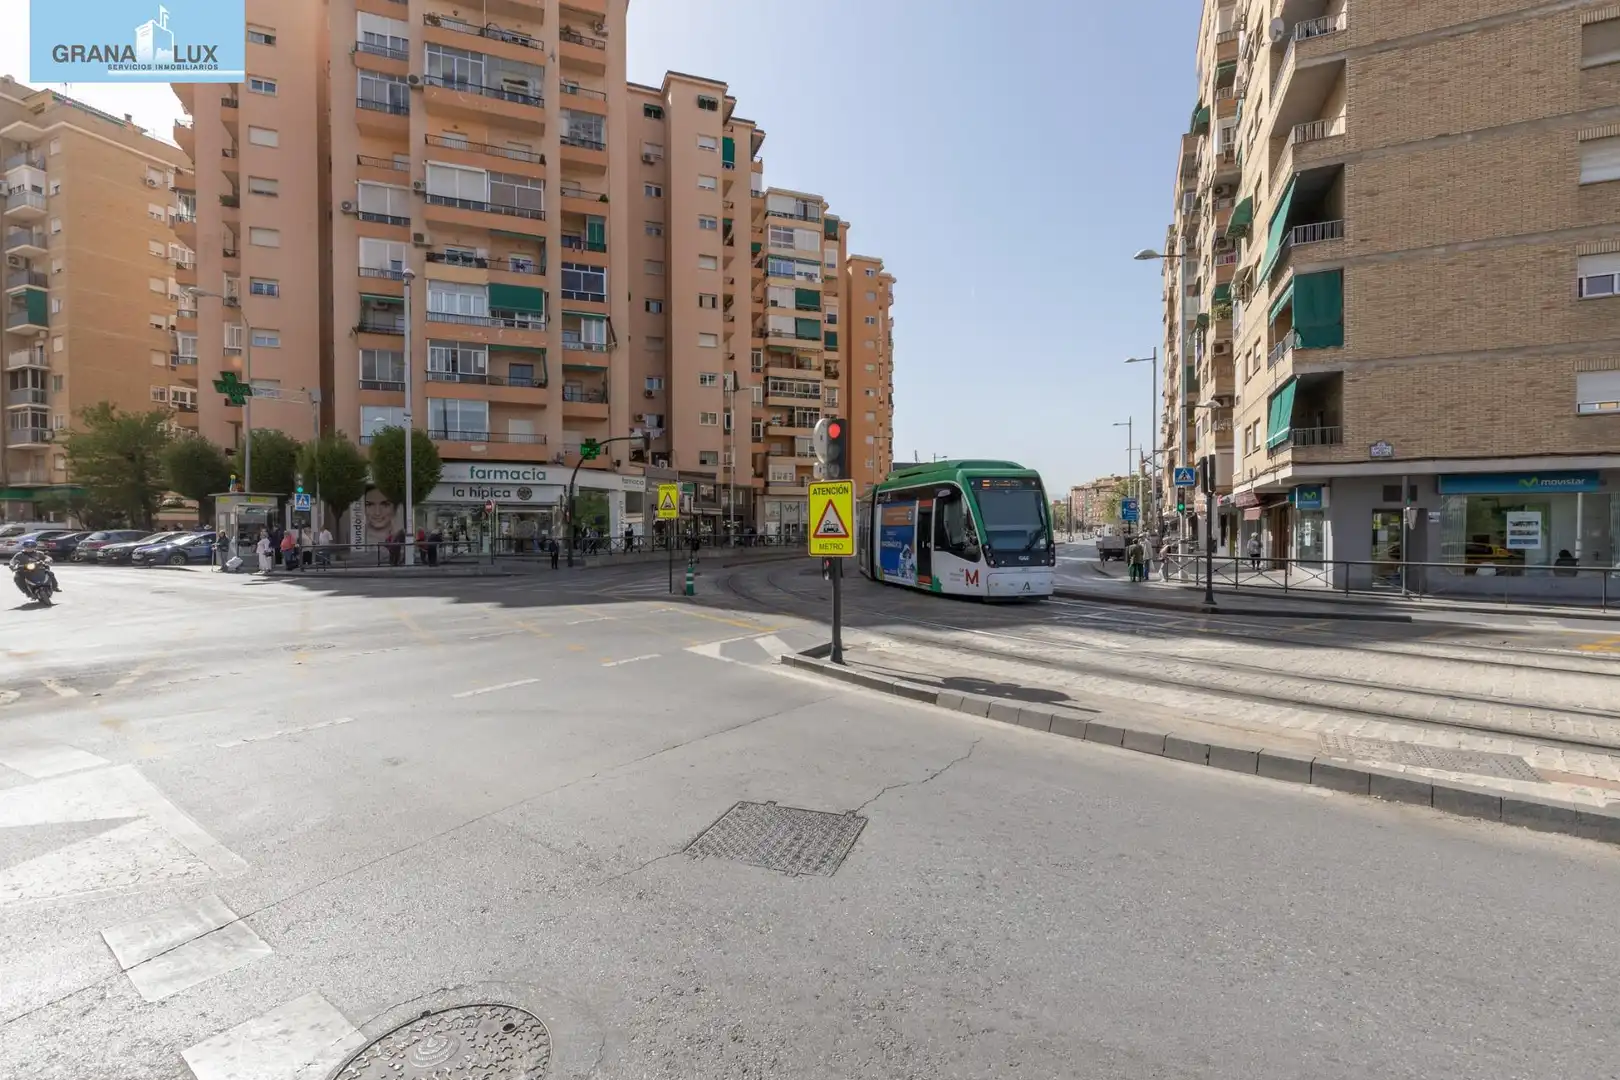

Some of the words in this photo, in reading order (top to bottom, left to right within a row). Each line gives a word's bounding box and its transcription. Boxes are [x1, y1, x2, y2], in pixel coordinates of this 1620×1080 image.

[470, 465, 547, 481] farmacia
[1540, 478, 1586, 486] movistar
[452, 486, 465, 498] la
[469, 485, 511, 500] hípica
[812, 485, 849, 496] ATENCIÓN
